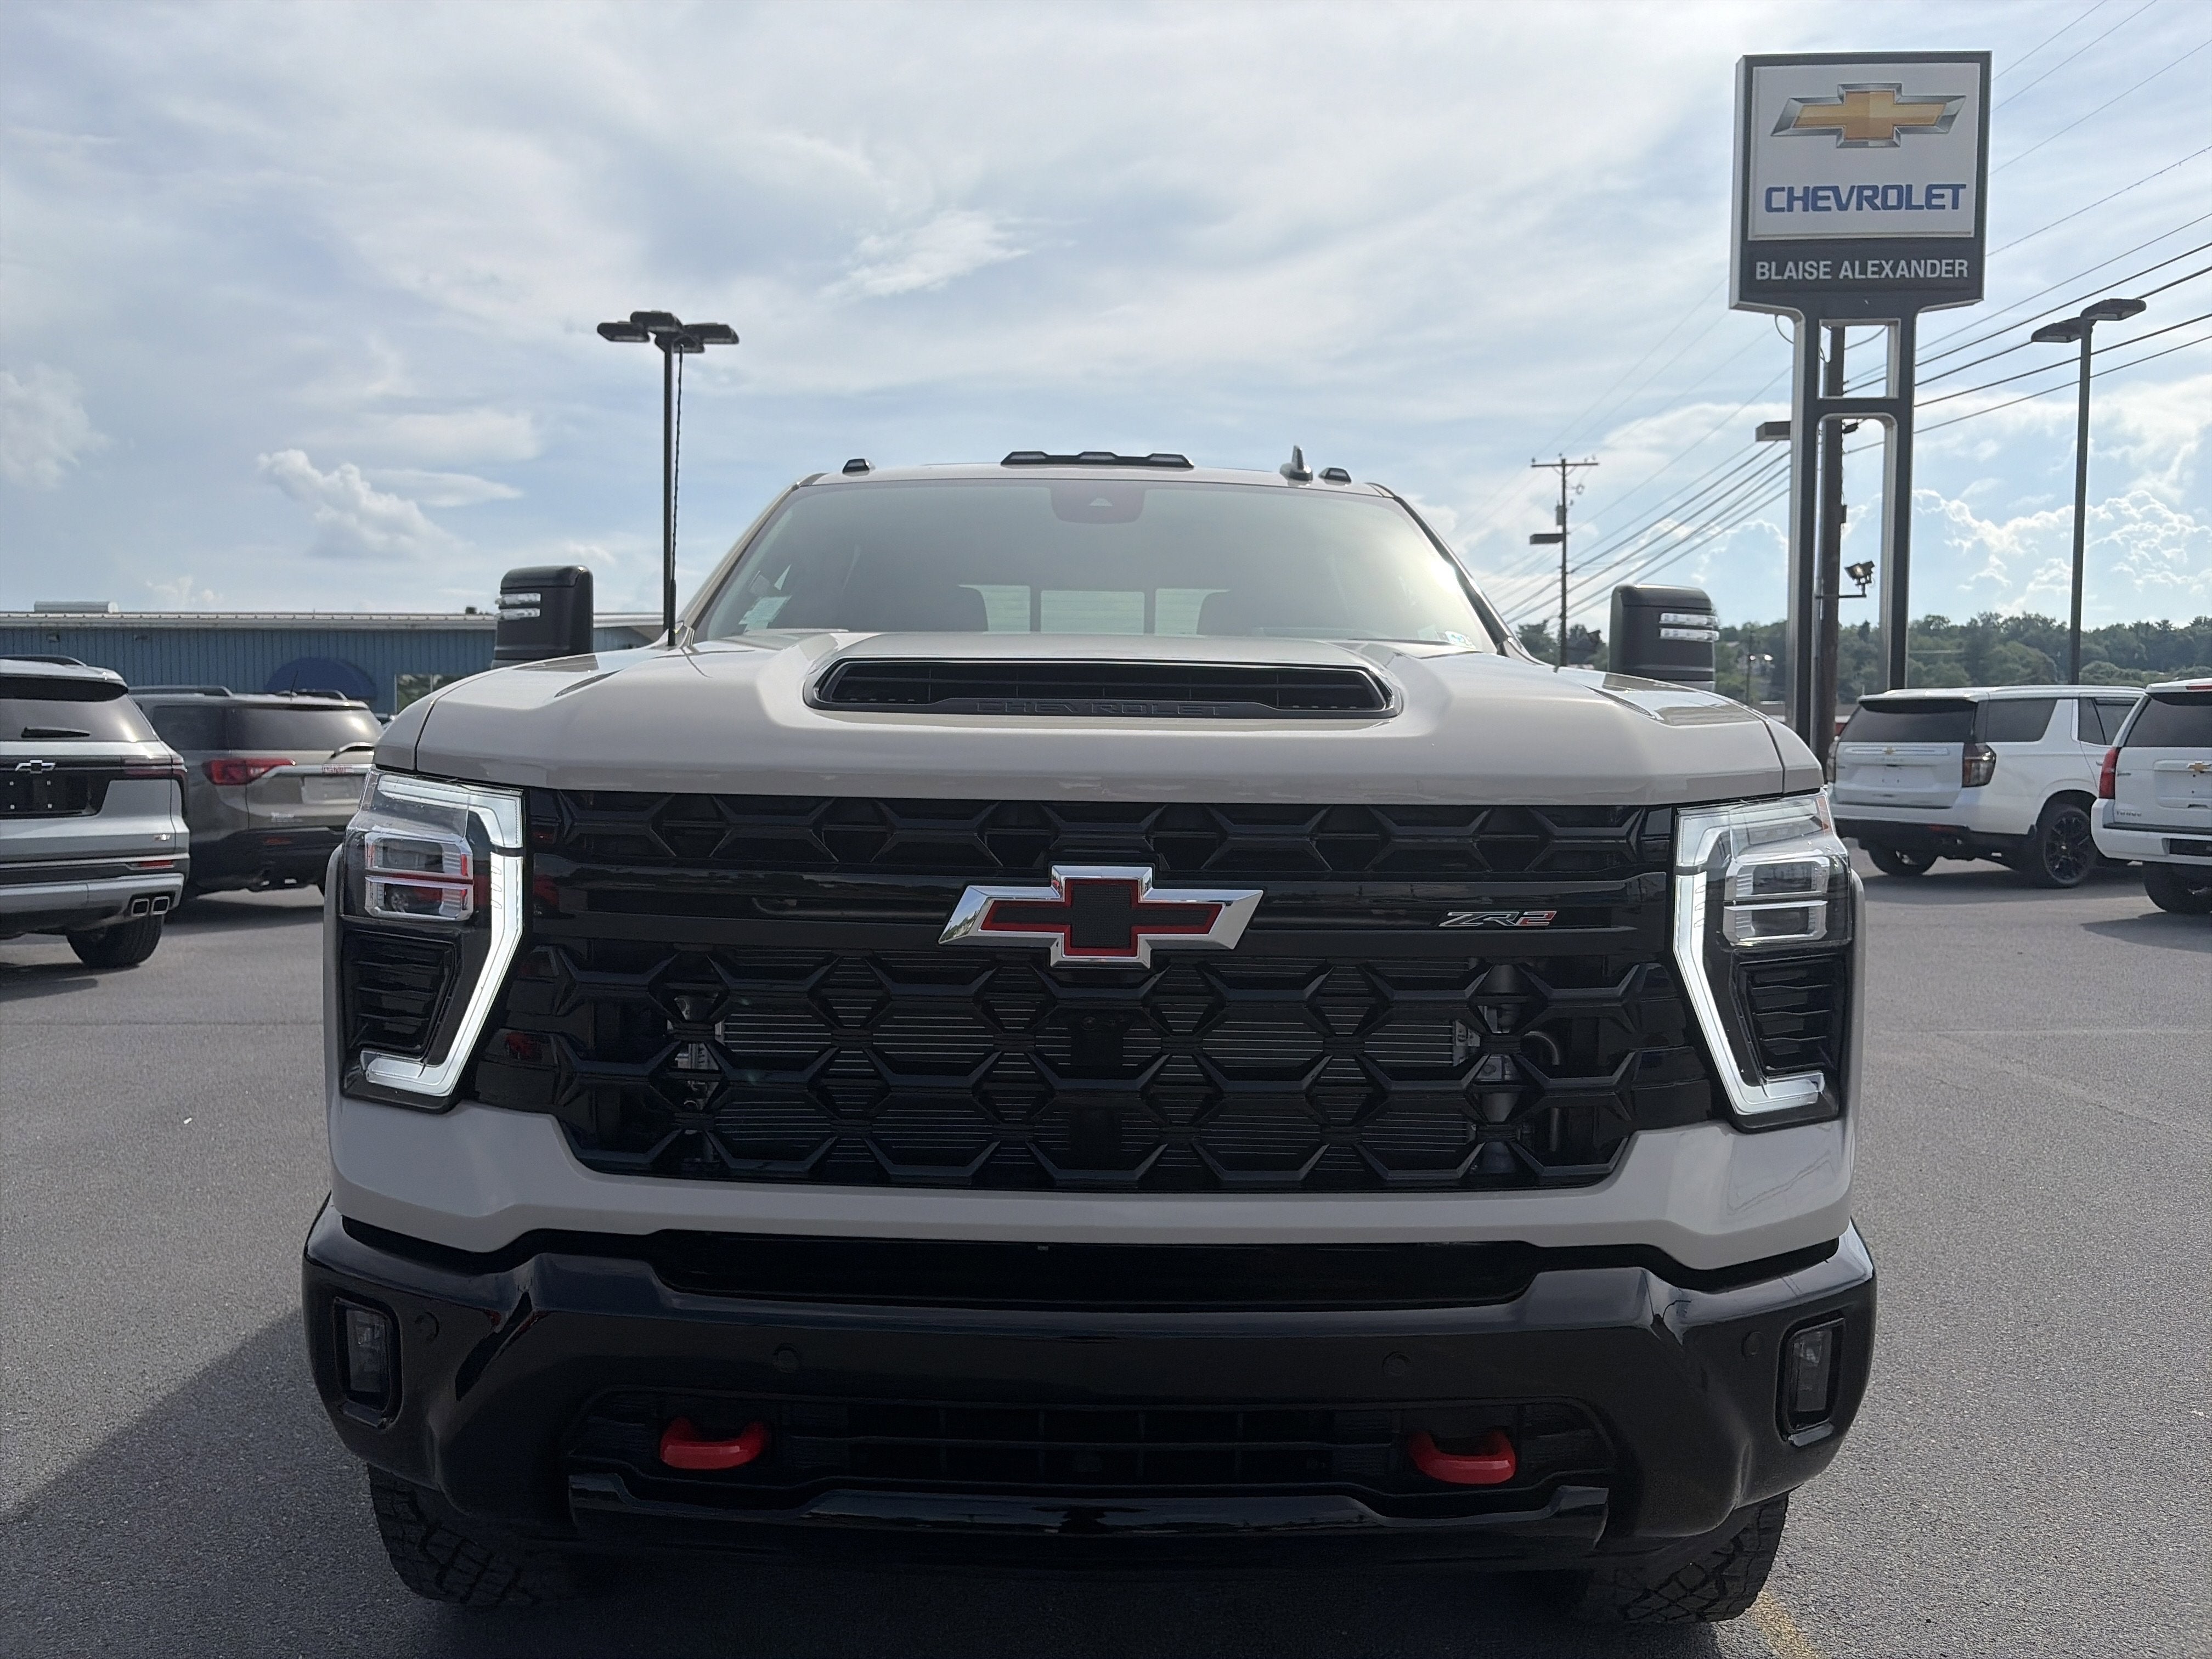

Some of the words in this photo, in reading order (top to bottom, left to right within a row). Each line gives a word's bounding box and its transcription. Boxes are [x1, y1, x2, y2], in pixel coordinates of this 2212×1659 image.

[1765, 184, 1966, 212] CHEVROLET
[1756, 261, 1832, 280] BLAISE
[1839, 259, 1968, 279] ALEXANDER
[977, 702, 1229, 715] CHEVROLET
[1438, 911, 1557, 927] ZR2
